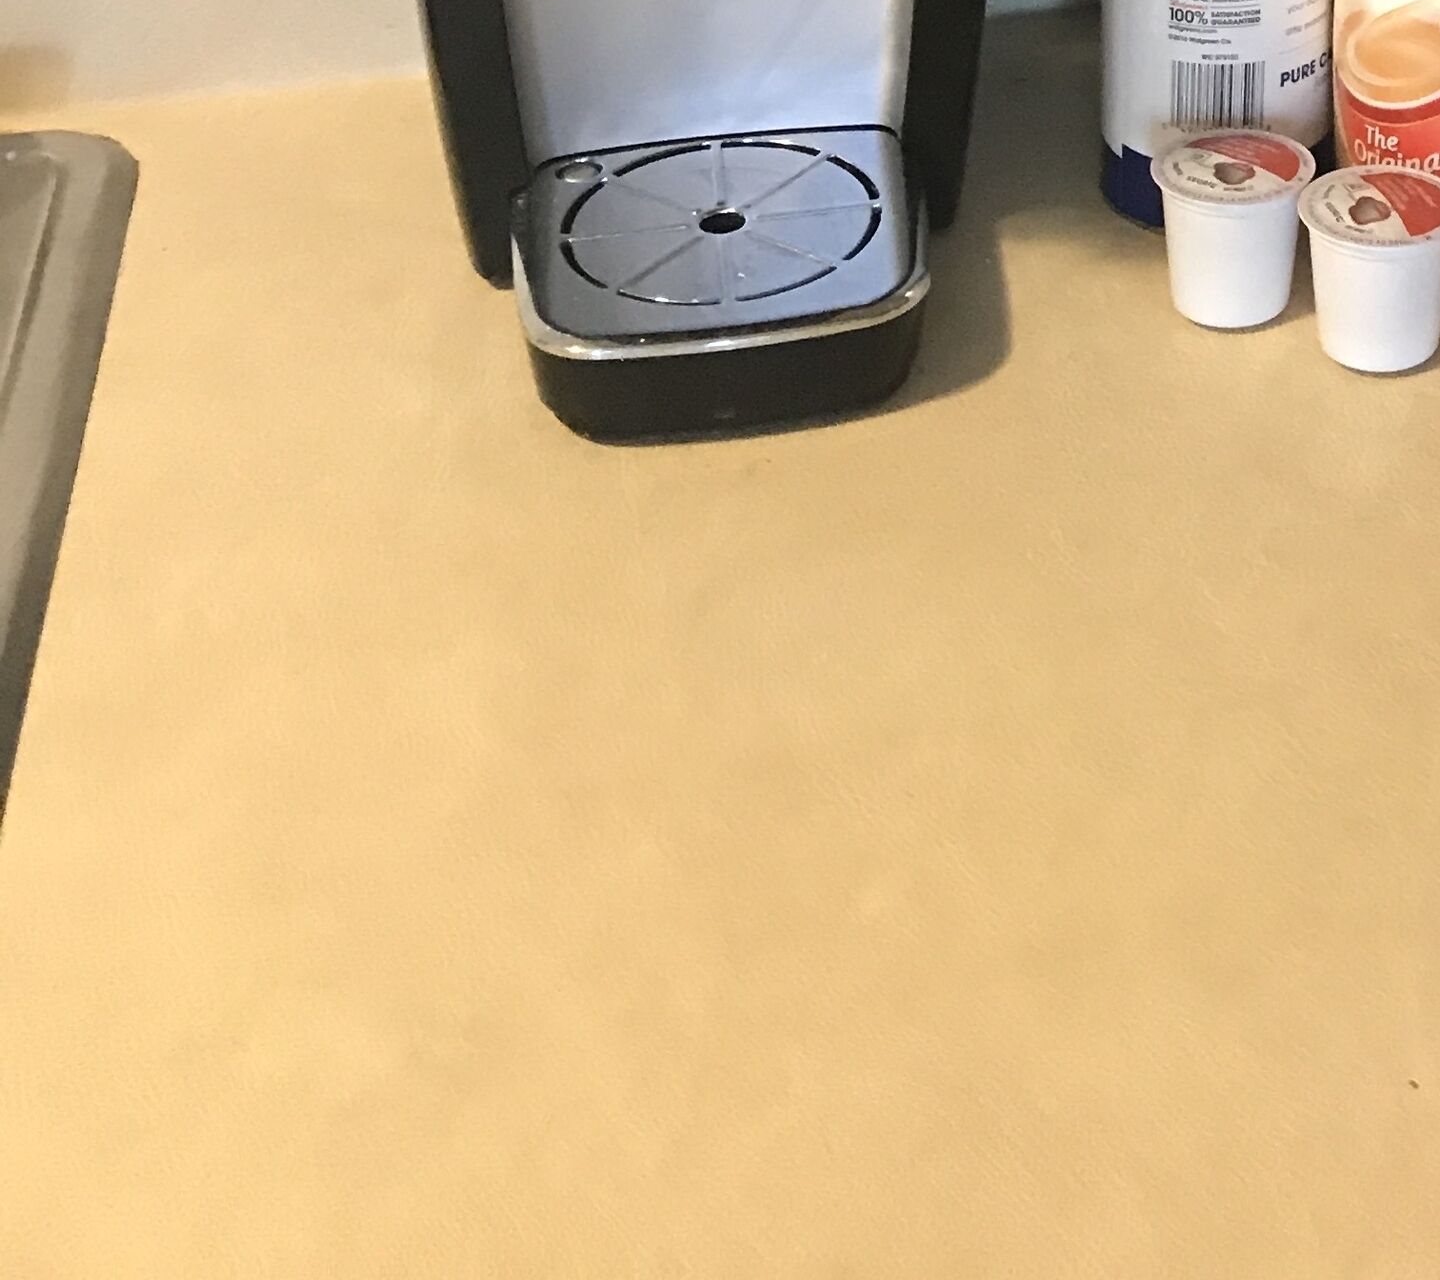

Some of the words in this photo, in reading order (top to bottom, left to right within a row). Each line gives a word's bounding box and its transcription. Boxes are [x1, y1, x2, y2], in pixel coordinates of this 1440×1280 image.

[1168, 6, 1209, 26] 100%
[1280, 59, 1316, 88] PURE
[1364, 124, 1399, 152] The
